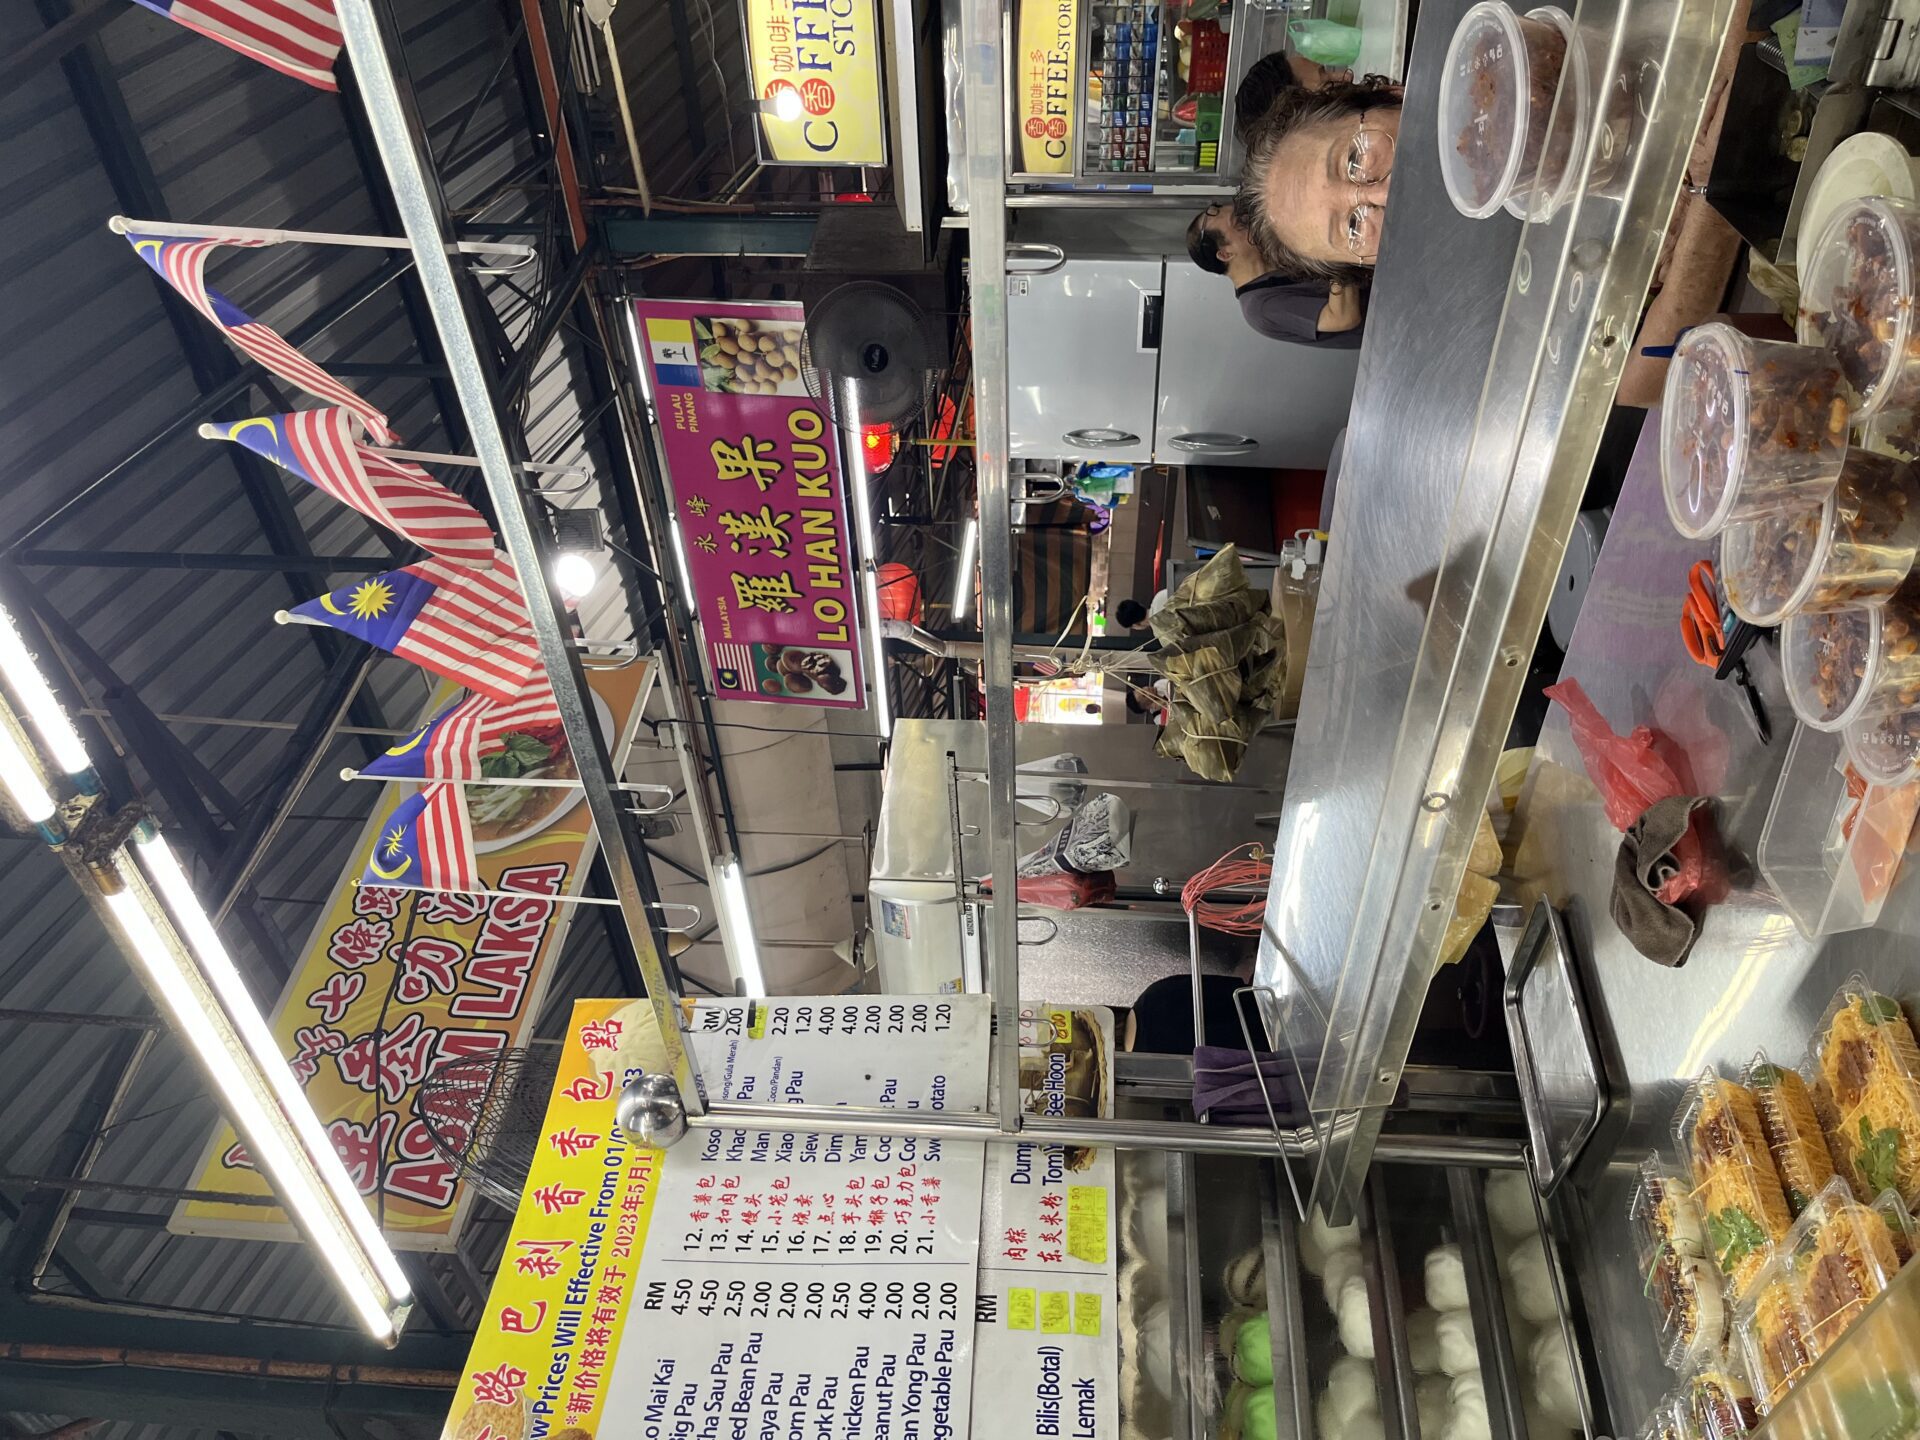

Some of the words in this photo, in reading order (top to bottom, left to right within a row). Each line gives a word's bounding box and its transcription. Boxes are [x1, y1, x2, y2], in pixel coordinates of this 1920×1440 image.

[1028, 48, 1045, 115] 咖啡士多
[670, 394, 686, 430] PULAU
[683, 392, 699, 433] PINANG
[786, 409, 832, 498] KUO
[686, 495, 718, 554] 永峰
[710, 435, 803, 614] 羅漢果
[800, 509, 843, 589] HAN
[717, 595, 733, 639] MALAYSIA
[812, 597, 849, 642] LO
[446, 860, 568, 1020] LAKSA
[725, 1008, 743, 1036] 2.00
[841, 1006, 858, 1035] 4.00
[887, 1005, 904, 1033] 2.00
[911, 1004, 928, 1033] 2.00
[934, 1004, 951, 1032] 1.20
[736, 1076, 755, 1100] Pau
[879, 1079, 897, 1103] Pau
[1044, 1054, 1064, 1091] Hoon
[383, 1028, 510, 1208] ASAM
[734, 1230, 755, 1253] 14.
[771, 1007, 789, 1035] 2.20
[761, 1230, 780, 1254] 15.
[785, 1071, 803, 1095] Pau
[795, 1007, 812, 1034] 1.20
[786, 1230, 806, 1254] 16.
[818, 1007, 835, 1035] 4.00
[838, 1230, 857, 1254] 18.
[864, 1005, 881, 1034] 2.00
[1042, 1154, 1063, 1186] Tom
[589, 1171, 620, 1218] From
[689, 1175, 716, 1223] 香薯包
[714, 1175, 740, 1224] 扣肉包
[817, 1193, 836, 1225] 点心
[893, 1163, 916, 1225] 巧克力包
[919, 1176, 942, 1225] 小香薯
[683, 1228, 703, 1251] 12.
[709, 1229, 729, 1252] 13.
[812, 1231, 831, 1254] 17.
[864, 1230, 882, 1254] 19.
[889, 1229, 908, 1254] 20.
[916, 1229, 935, 1254] 21.
[1036, 1192, 1063, 1263] 东炎米粉
[565, 1222, 607, 1305] Effective
[643, 1282, 667, 1310] RM
[671, 1279, 693, 1315] 4.50
[723, 1280, 746, 1317] 2.50
[750, 1281, 772, 1318] 2.00
[857, 1282, 877, 1320] 4.00
[884, 1282, 904, 1320] 2.00
[911, 1282, 931, 1320] 2.00
[938, 1282, 958, 1321] 2.00
[975, 1295, 997, 1323] RM
[551, 1310, 582, 1348] Will
[673, 1383, 698, 1416] Pau
[698, 1279, 719, 1316] 4.50
[740, 1332, 763, 1364] Pau
[761, 1372, 784, 1406] Pau
[777, 1281, 799, 1319] 2.00
[789, 1373, 811, 1407] Pau
[803, 1282, 825, 1319] 2.00
[816, 1376, 838, 1410] Pau
[830, 1282, 851, 1319] 2.50
[934, 1329, 954, 1362] Pau
[710, 1343, 734, 1375] Pau
[848, 1346, 870, 1379] Pau
[906, 1333, 926, 1366] Pau
[531, 1351, 571, 1415] Prices
[652, 1359, 676, 1385] Kai
[875, 1354, 896, 1387] Pau
[643, 1389, 669, 1422] Mai
[703, 1379, 727, 1412] Sau
[731, 1368, 757, 1413] Bean
[901, 1370, 928, 1416] Yong
[1036, 1346, 1064, 1436] Bilis(Botal)
[1071, 1377, 1095, 1438] Lemak
